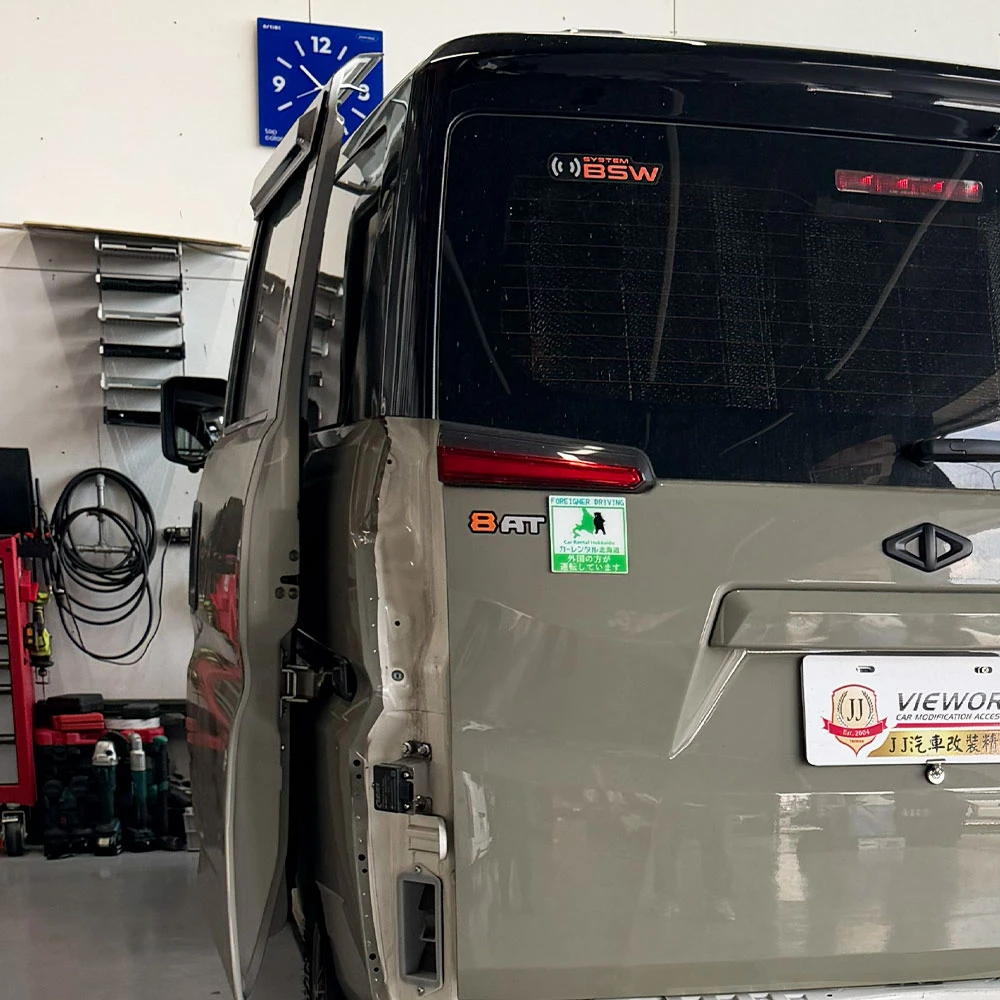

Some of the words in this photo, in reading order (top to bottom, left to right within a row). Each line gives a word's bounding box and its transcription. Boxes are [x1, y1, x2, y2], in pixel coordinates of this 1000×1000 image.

[310, 35, 332, 54] 12
[272, 75, 286, 93] 9
[357, 83, 370, 101] 3
[582, 156, 629, 164] SYSTEM
[583, 163, 659, 182] BSW
[550, 497, 590, 505] FOREIGNER
[469, 511, 546, 534] 8AT
[847, 698, 863, 721] JJ
[896, 713, 913, 721] CAR
[914, 713, 972, 721] MODIFICATION
